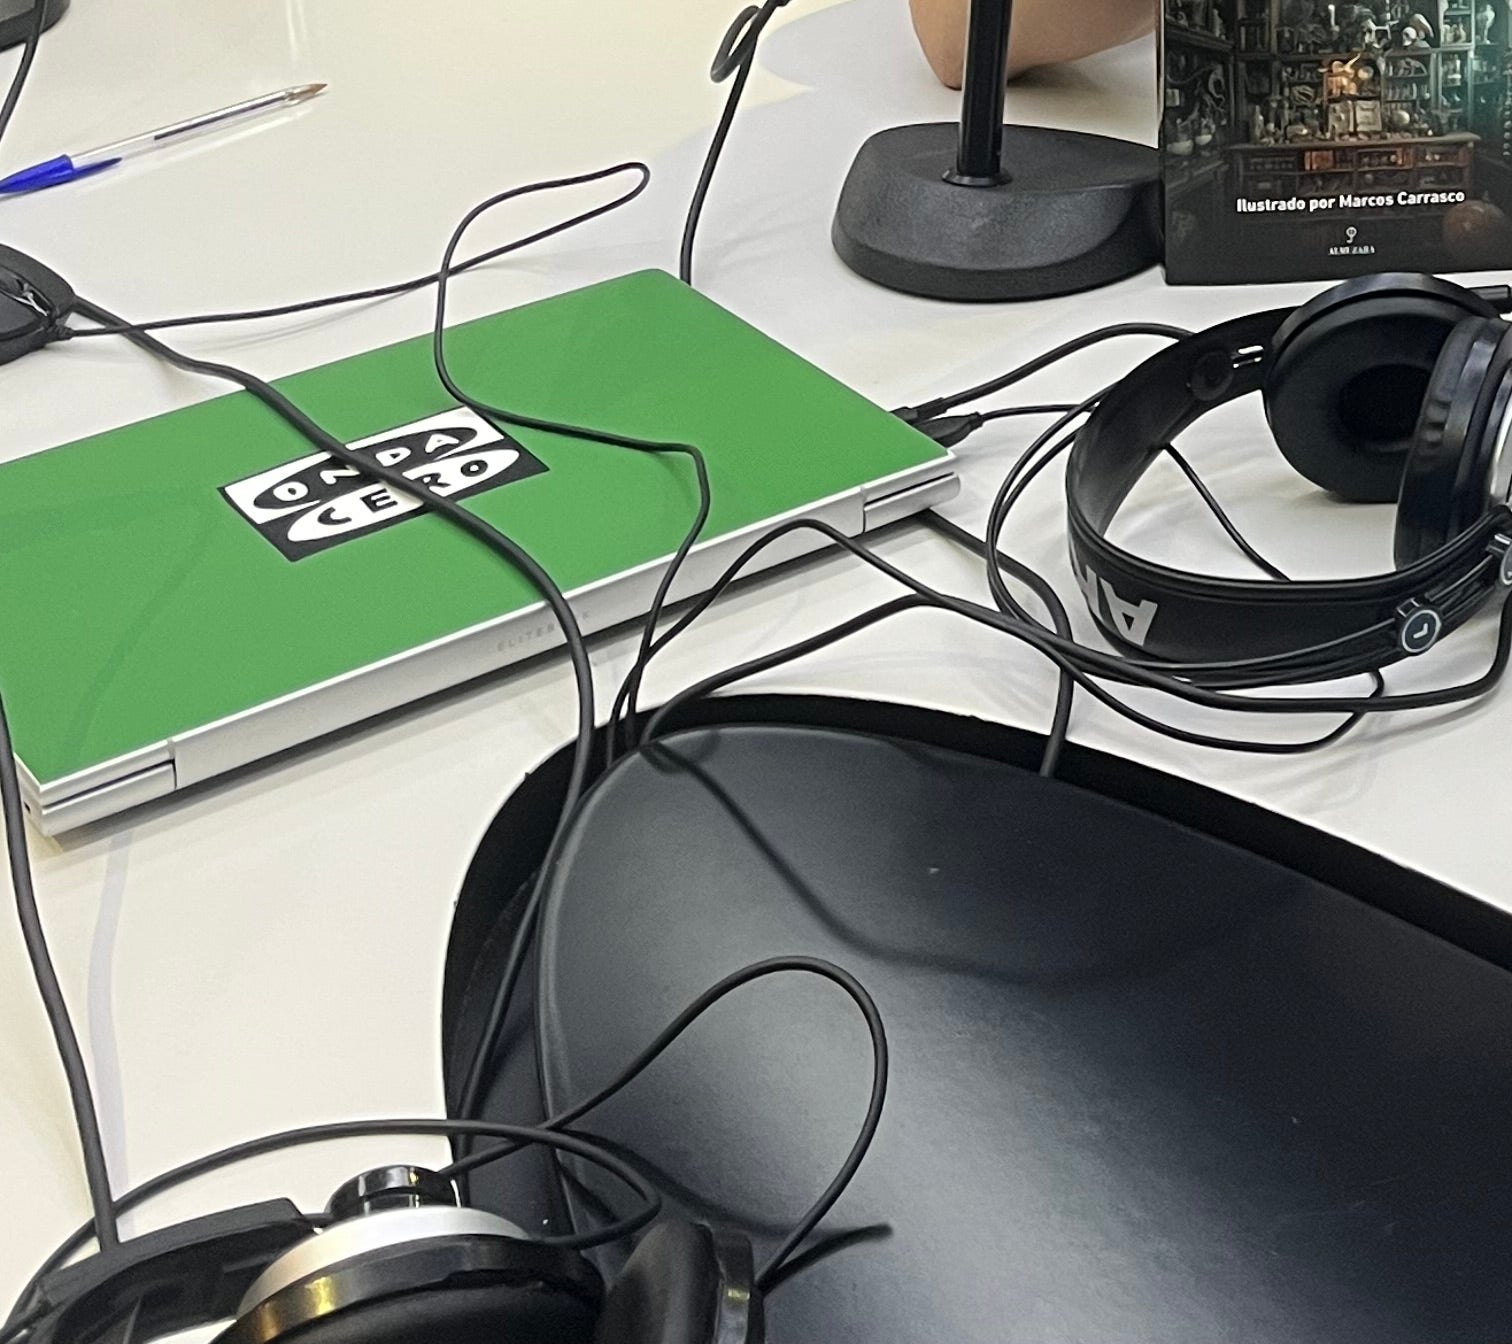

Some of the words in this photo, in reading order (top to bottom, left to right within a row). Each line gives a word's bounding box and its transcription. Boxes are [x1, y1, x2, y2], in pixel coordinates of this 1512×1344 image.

[1236, 196, 1306, 212] Ilustrado
[1309, 197, 1335, 212] por
[1339, 194, 1394, 208] Marcos
[1397, 190, 1465, 205] Carrasco
[272, 433, 460, 501] ONDA
[317, 459, 489, 526] CERO
